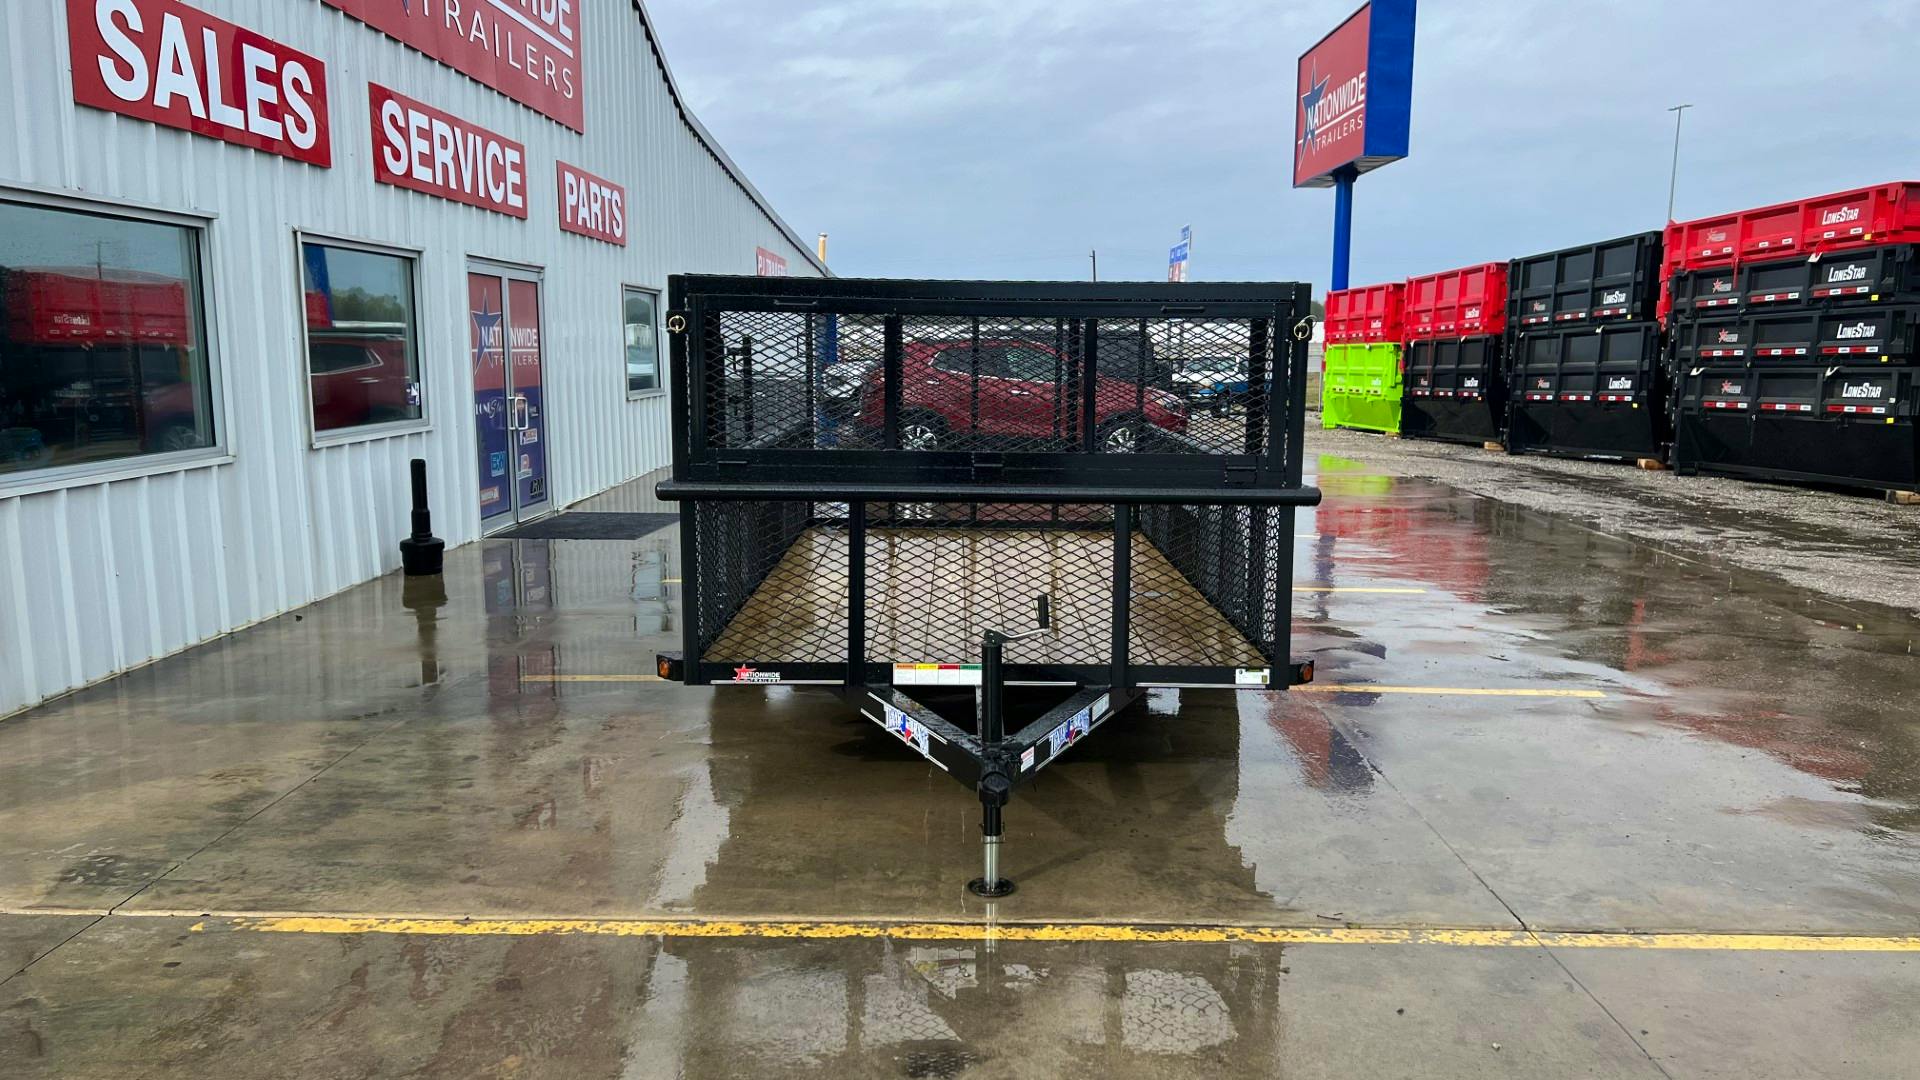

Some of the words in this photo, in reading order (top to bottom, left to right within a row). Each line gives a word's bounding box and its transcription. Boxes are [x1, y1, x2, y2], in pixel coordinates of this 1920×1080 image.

[95, 0, 317, 151] SALES
[1307, 71, 1366, 133] NATIONWIDE
[381, 99, 523, 208] SERVICE
[1316, 114, 1363, 152] TRAILERS
[565, 171, 624, 239] PARTS
[481, 326, 538, 347] NATINWIDE
